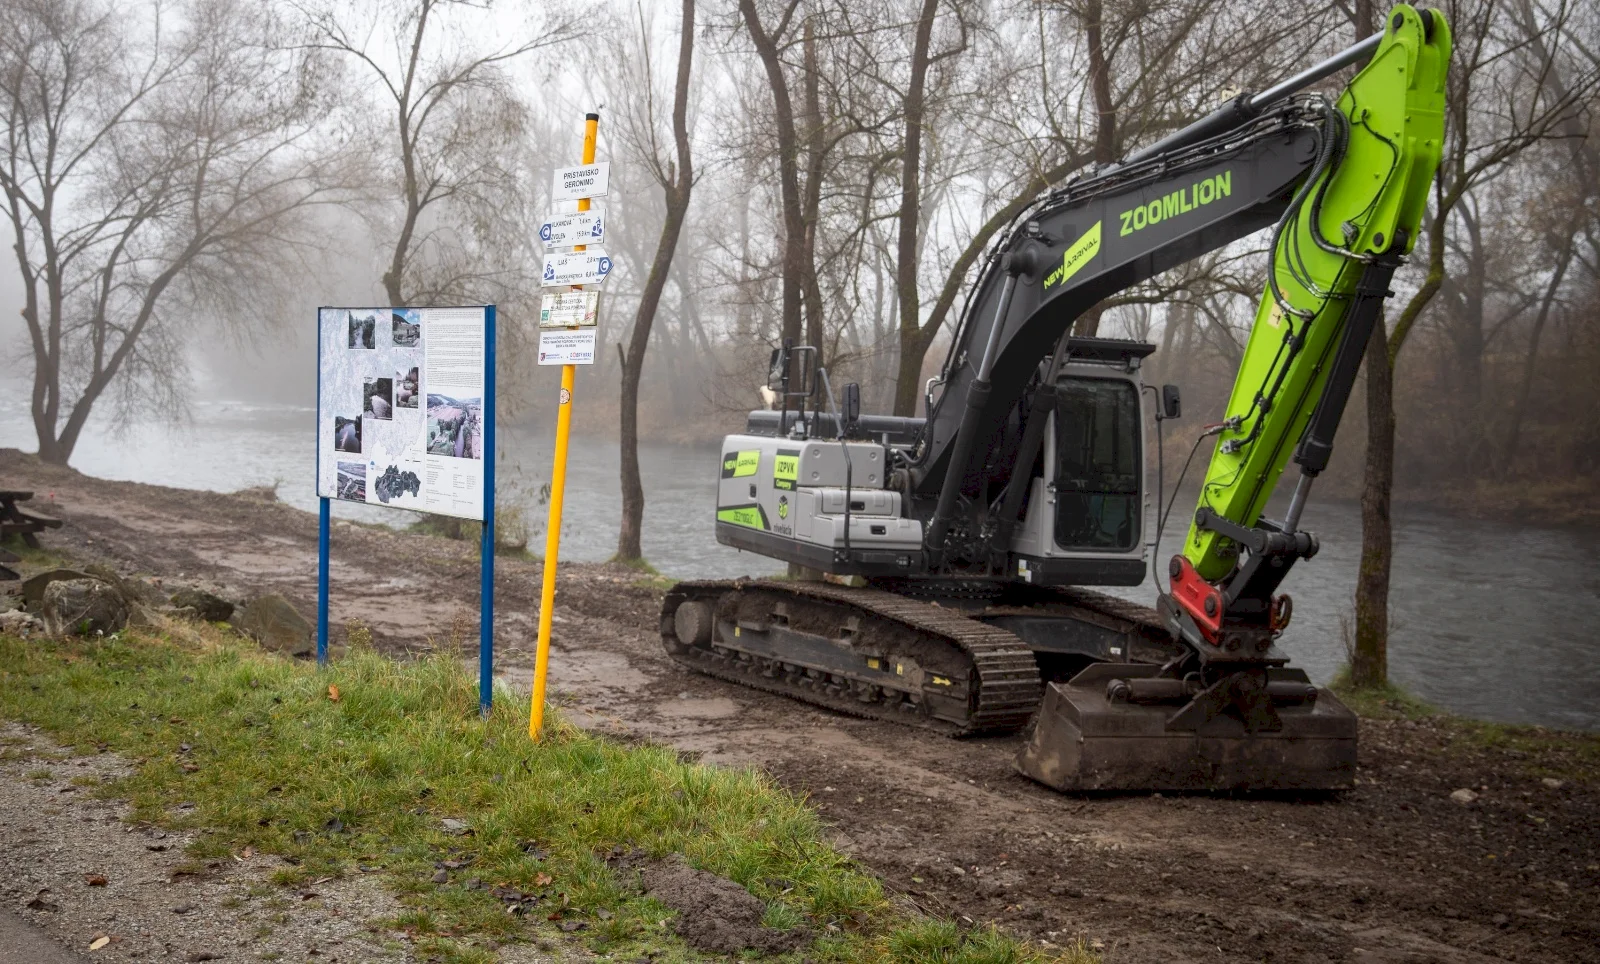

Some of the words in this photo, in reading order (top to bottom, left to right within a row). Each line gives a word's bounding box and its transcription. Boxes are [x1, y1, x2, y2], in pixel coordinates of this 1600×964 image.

[565, 178, 593, 188] GERONIMO
[1119, 170, 1232, 237] ZOOMLION
[1043, 264, 1064, 290] NEW
[1066, 237, 1099, 269] ARRIVAL
